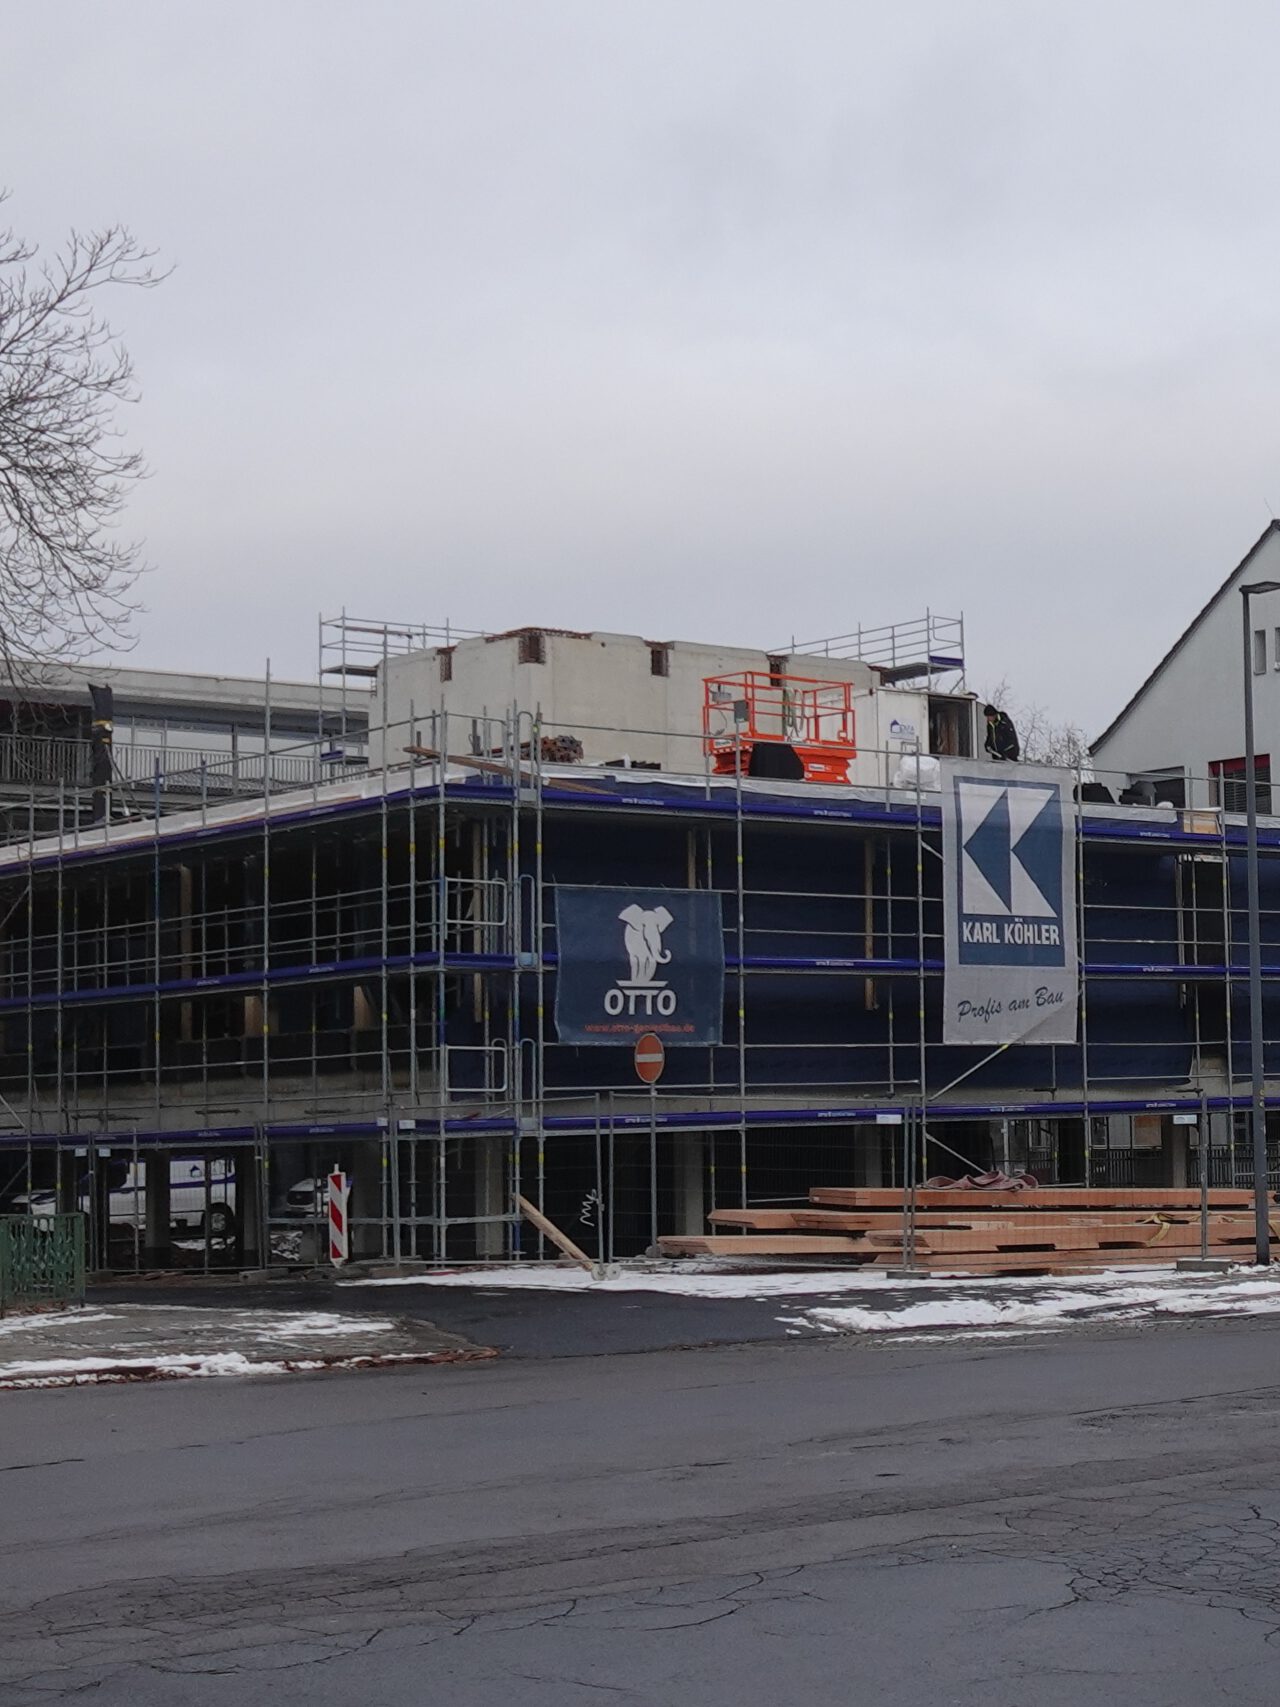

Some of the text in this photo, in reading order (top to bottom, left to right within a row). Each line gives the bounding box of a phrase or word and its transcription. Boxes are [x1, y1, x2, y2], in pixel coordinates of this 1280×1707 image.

[963, 917, 1061, 945] KARL KÖHLER
[604, 988, 677, 1016] OTTO
[957, 986, 1065, 1023] Profis am Bau
